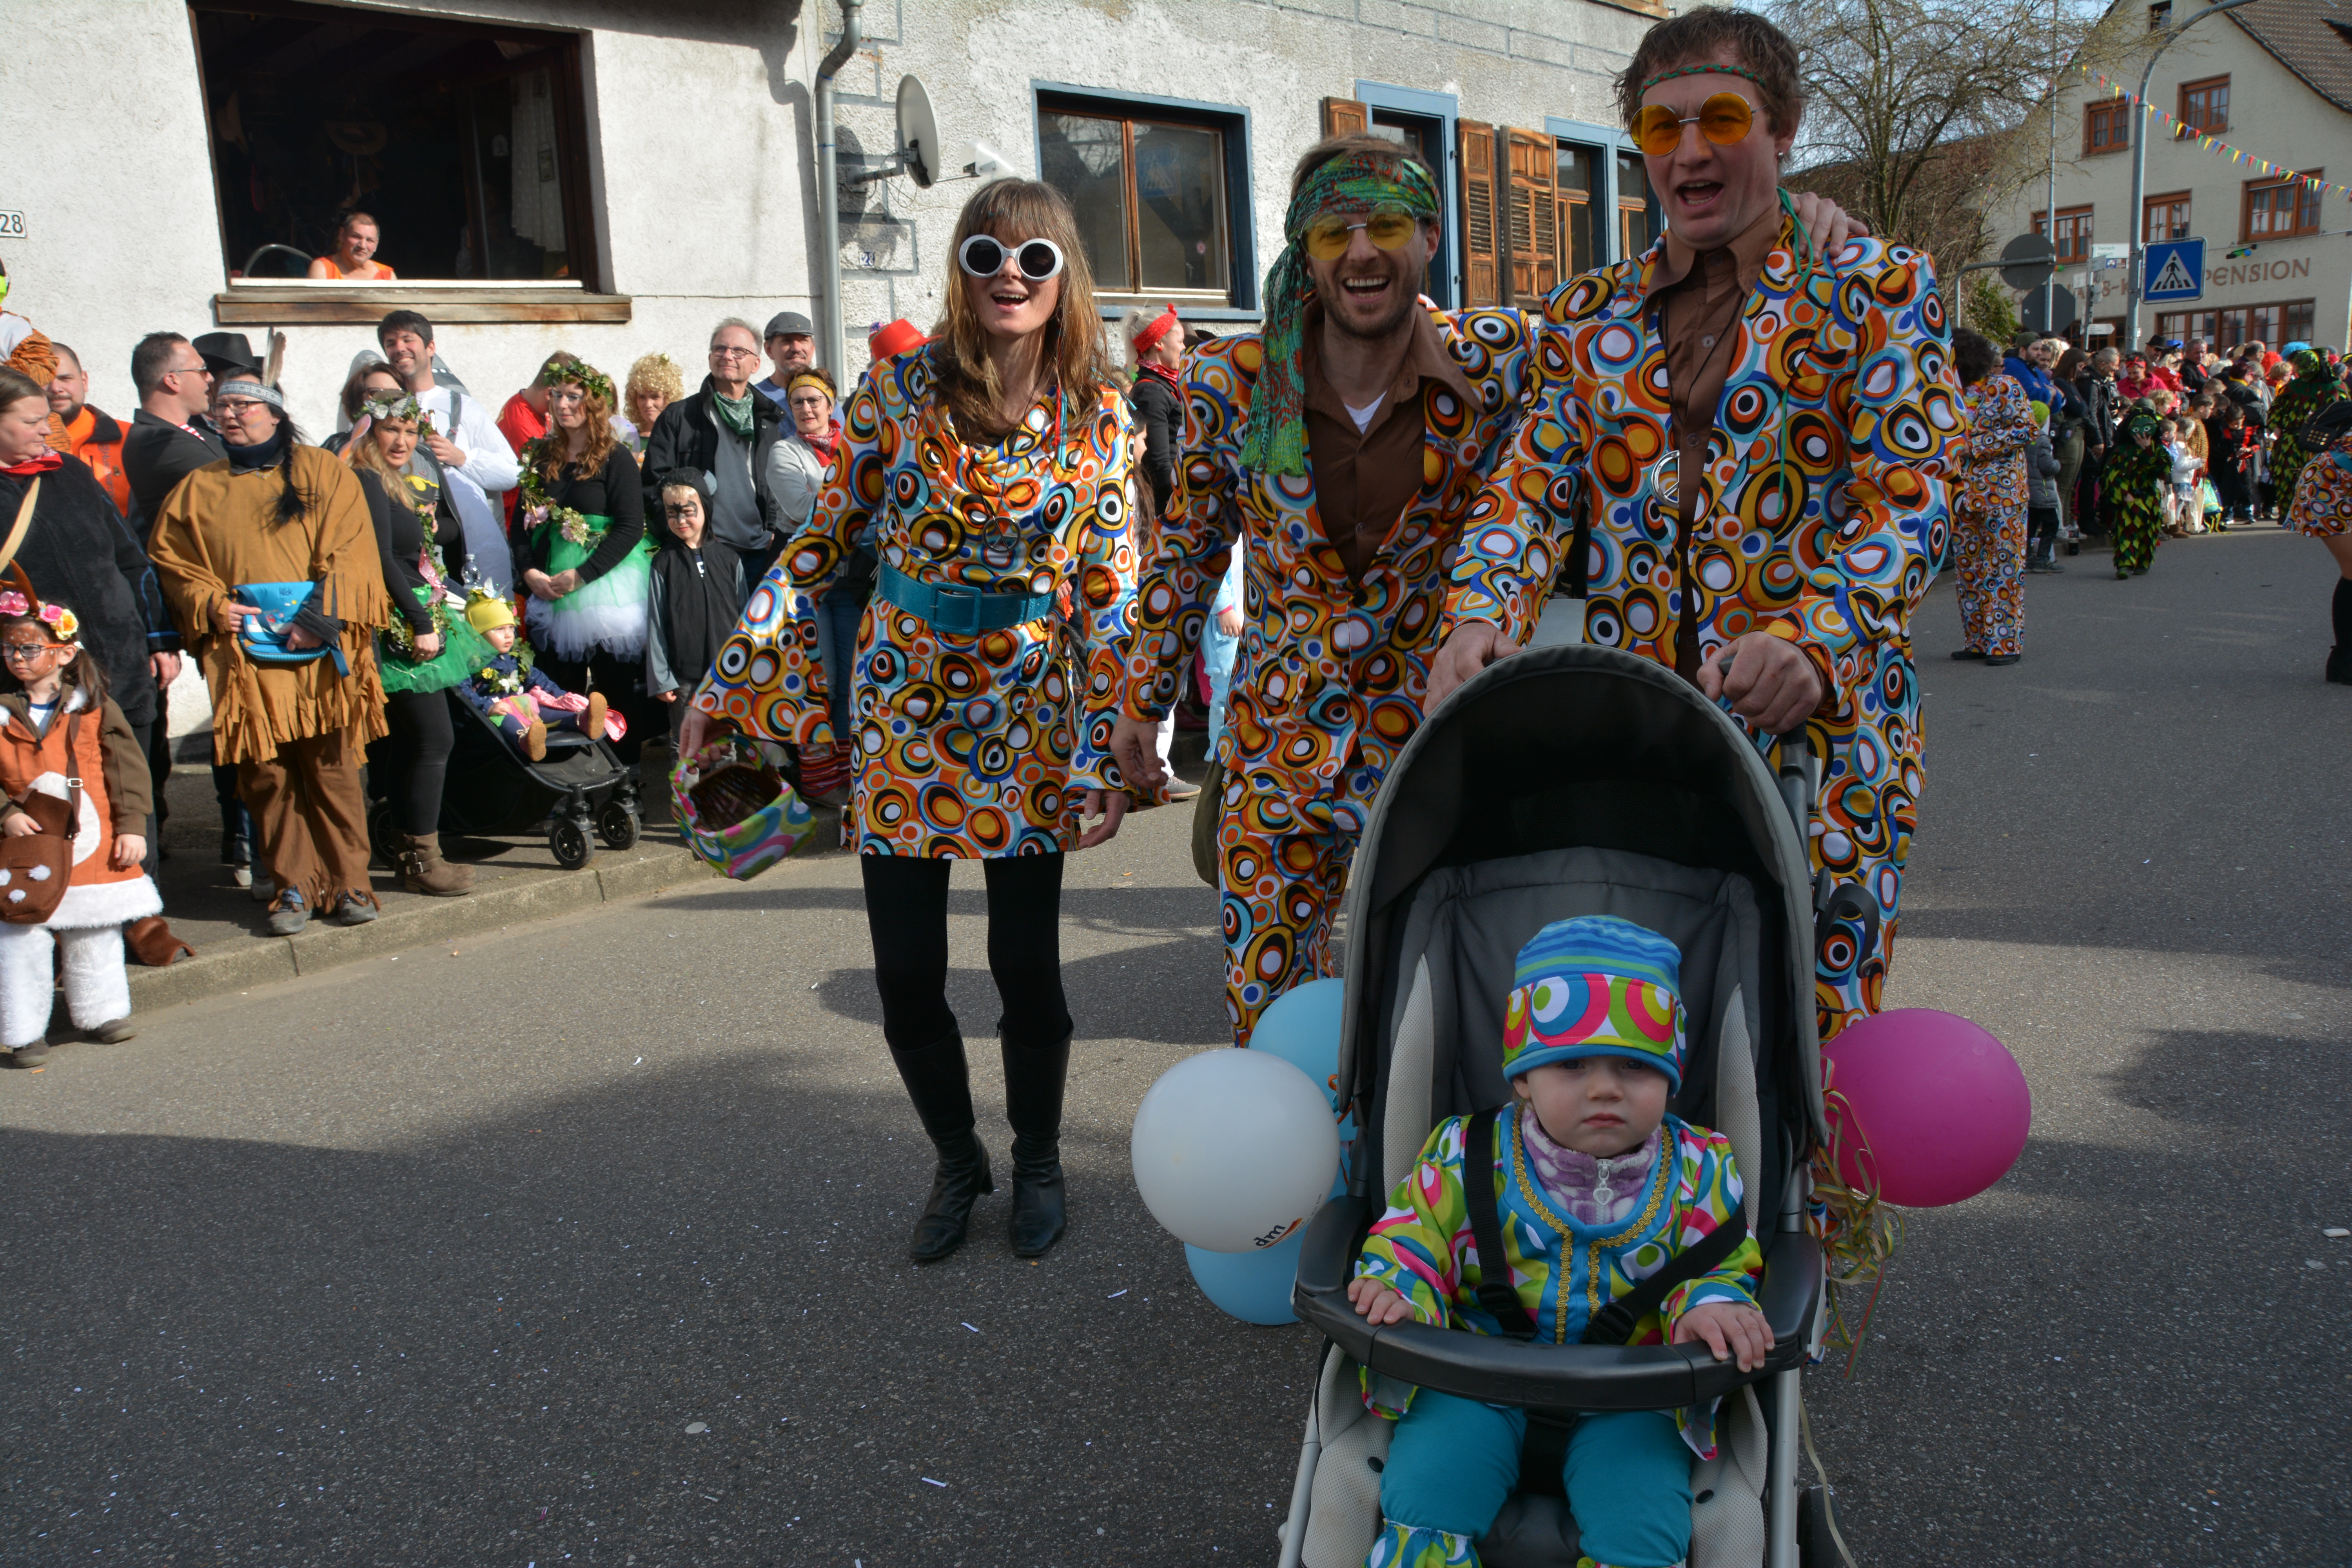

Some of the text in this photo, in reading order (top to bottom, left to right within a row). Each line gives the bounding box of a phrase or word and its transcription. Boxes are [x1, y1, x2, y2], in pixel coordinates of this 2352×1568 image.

[0, 214, 24, 234] 28
[861, 252, 874, 265] 28
[279, 587, 292, 596] Nick
[1253, 1225, 1286, 1246] dm
